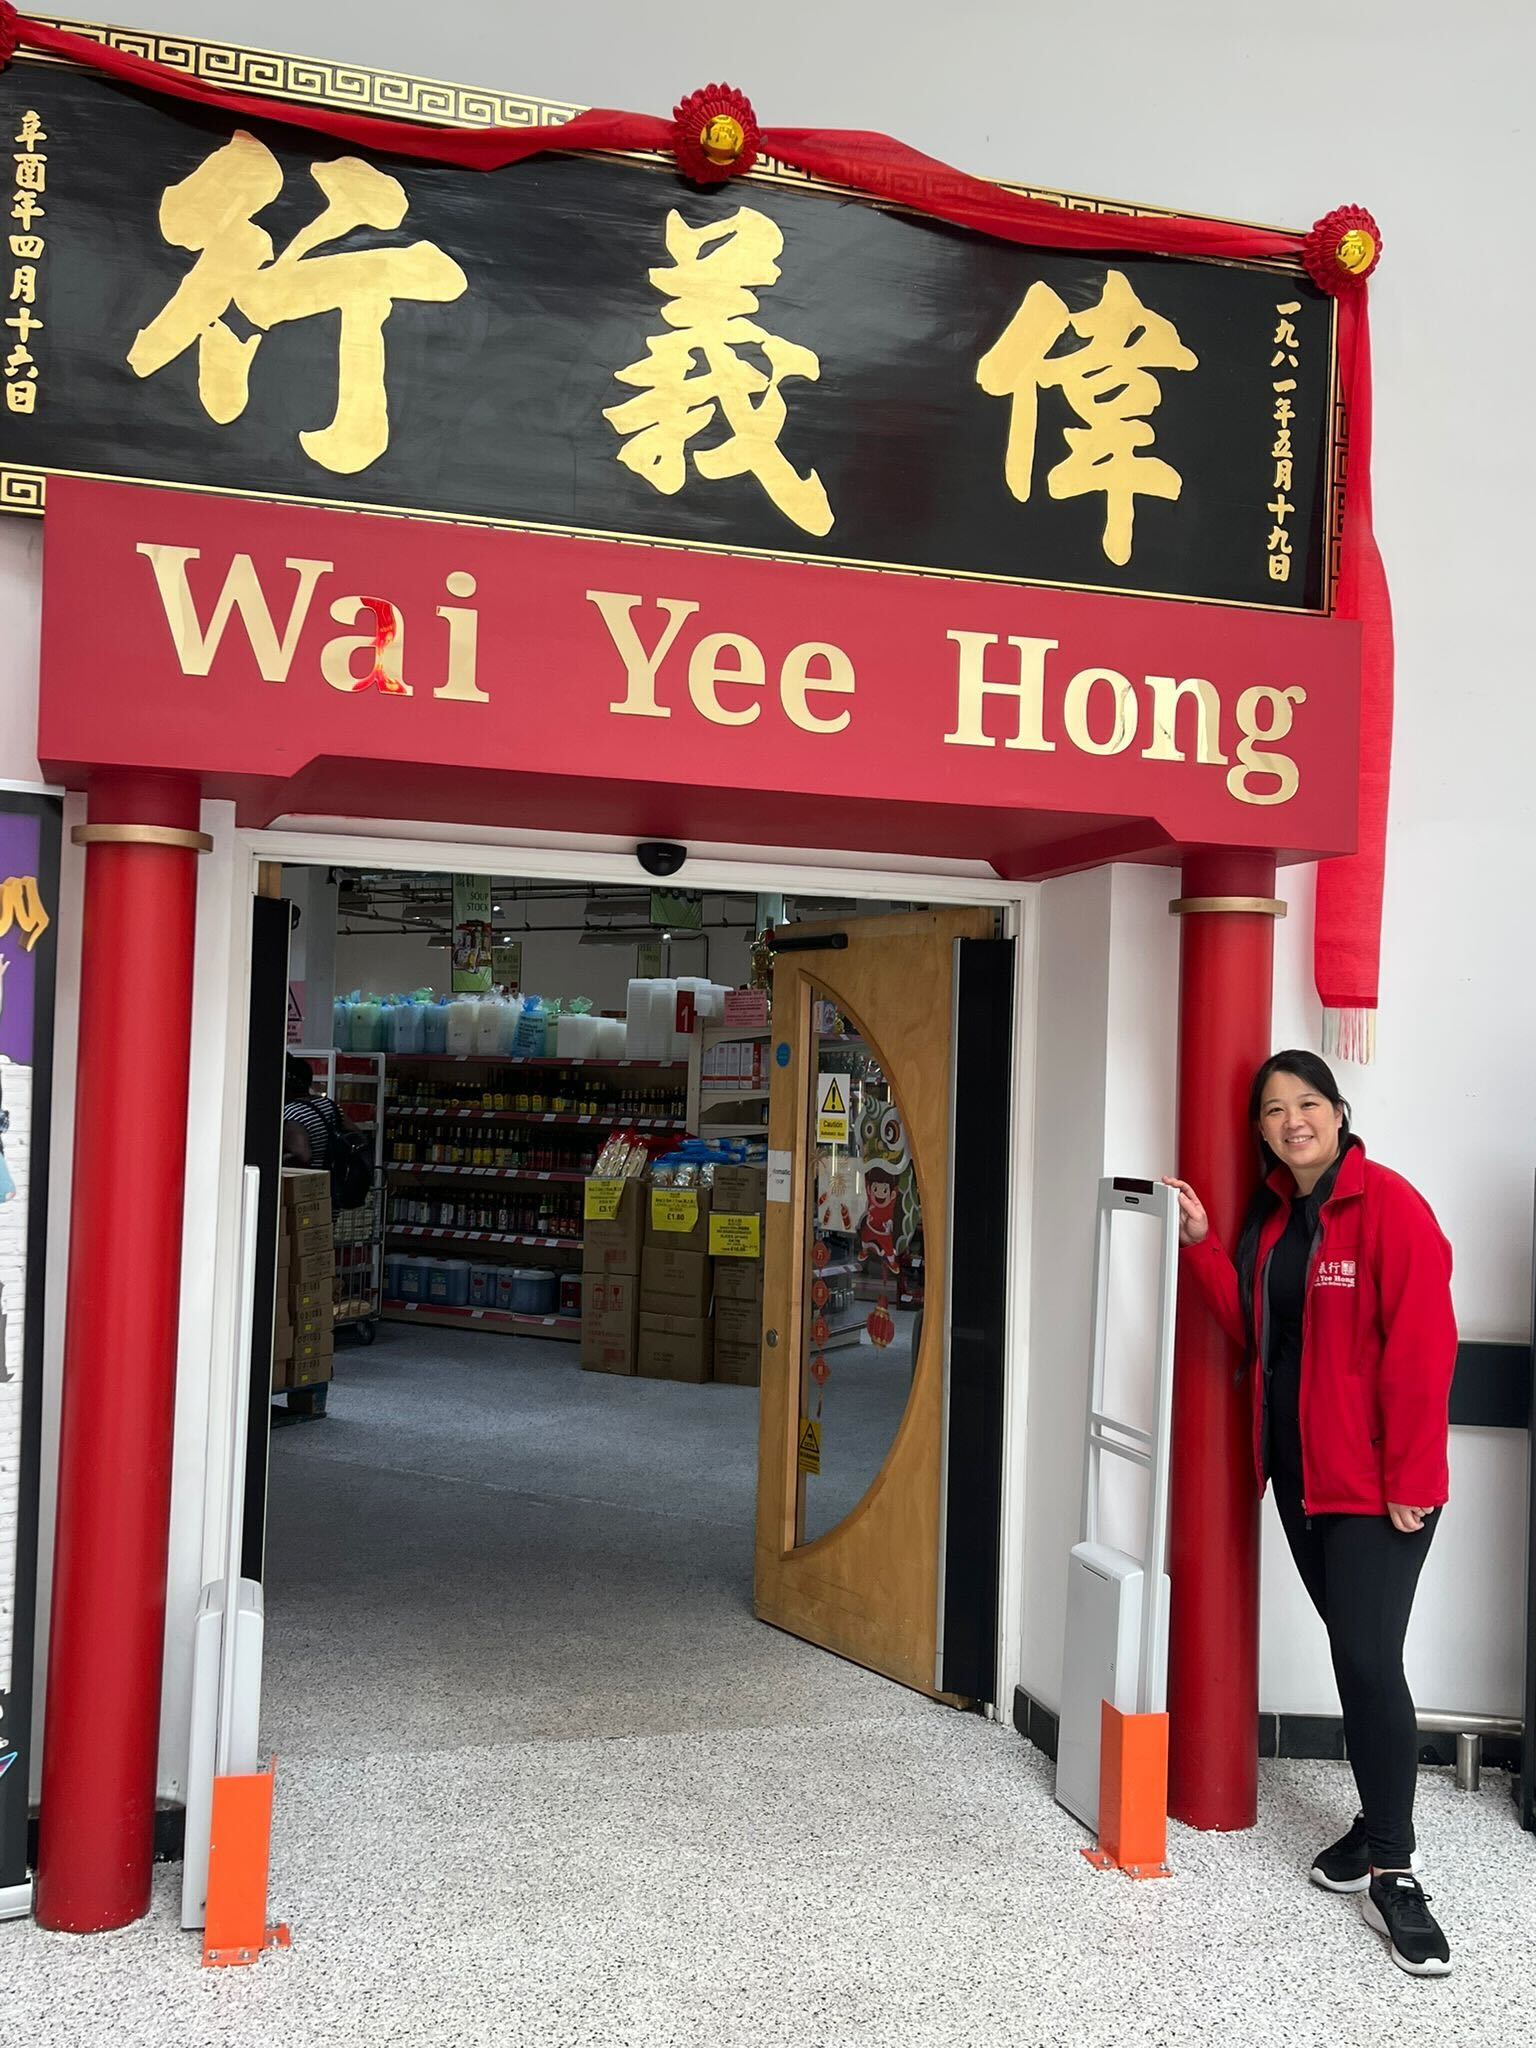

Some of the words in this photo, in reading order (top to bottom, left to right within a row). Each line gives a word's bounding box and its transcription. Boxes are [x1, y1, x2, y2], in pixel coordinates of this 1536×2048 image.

[1266, 300, 1302, 582] 一九八一年五月十九日
[136, 542, 490, 703] Wai
[586, 590, 856, 734] Yee
[943, 629, 1307, 805] Hong
[466, 902, 489, 912] STOCK
[470, 891, 489, 901] SOUP
[681, 1005, 689, 1032] 1
